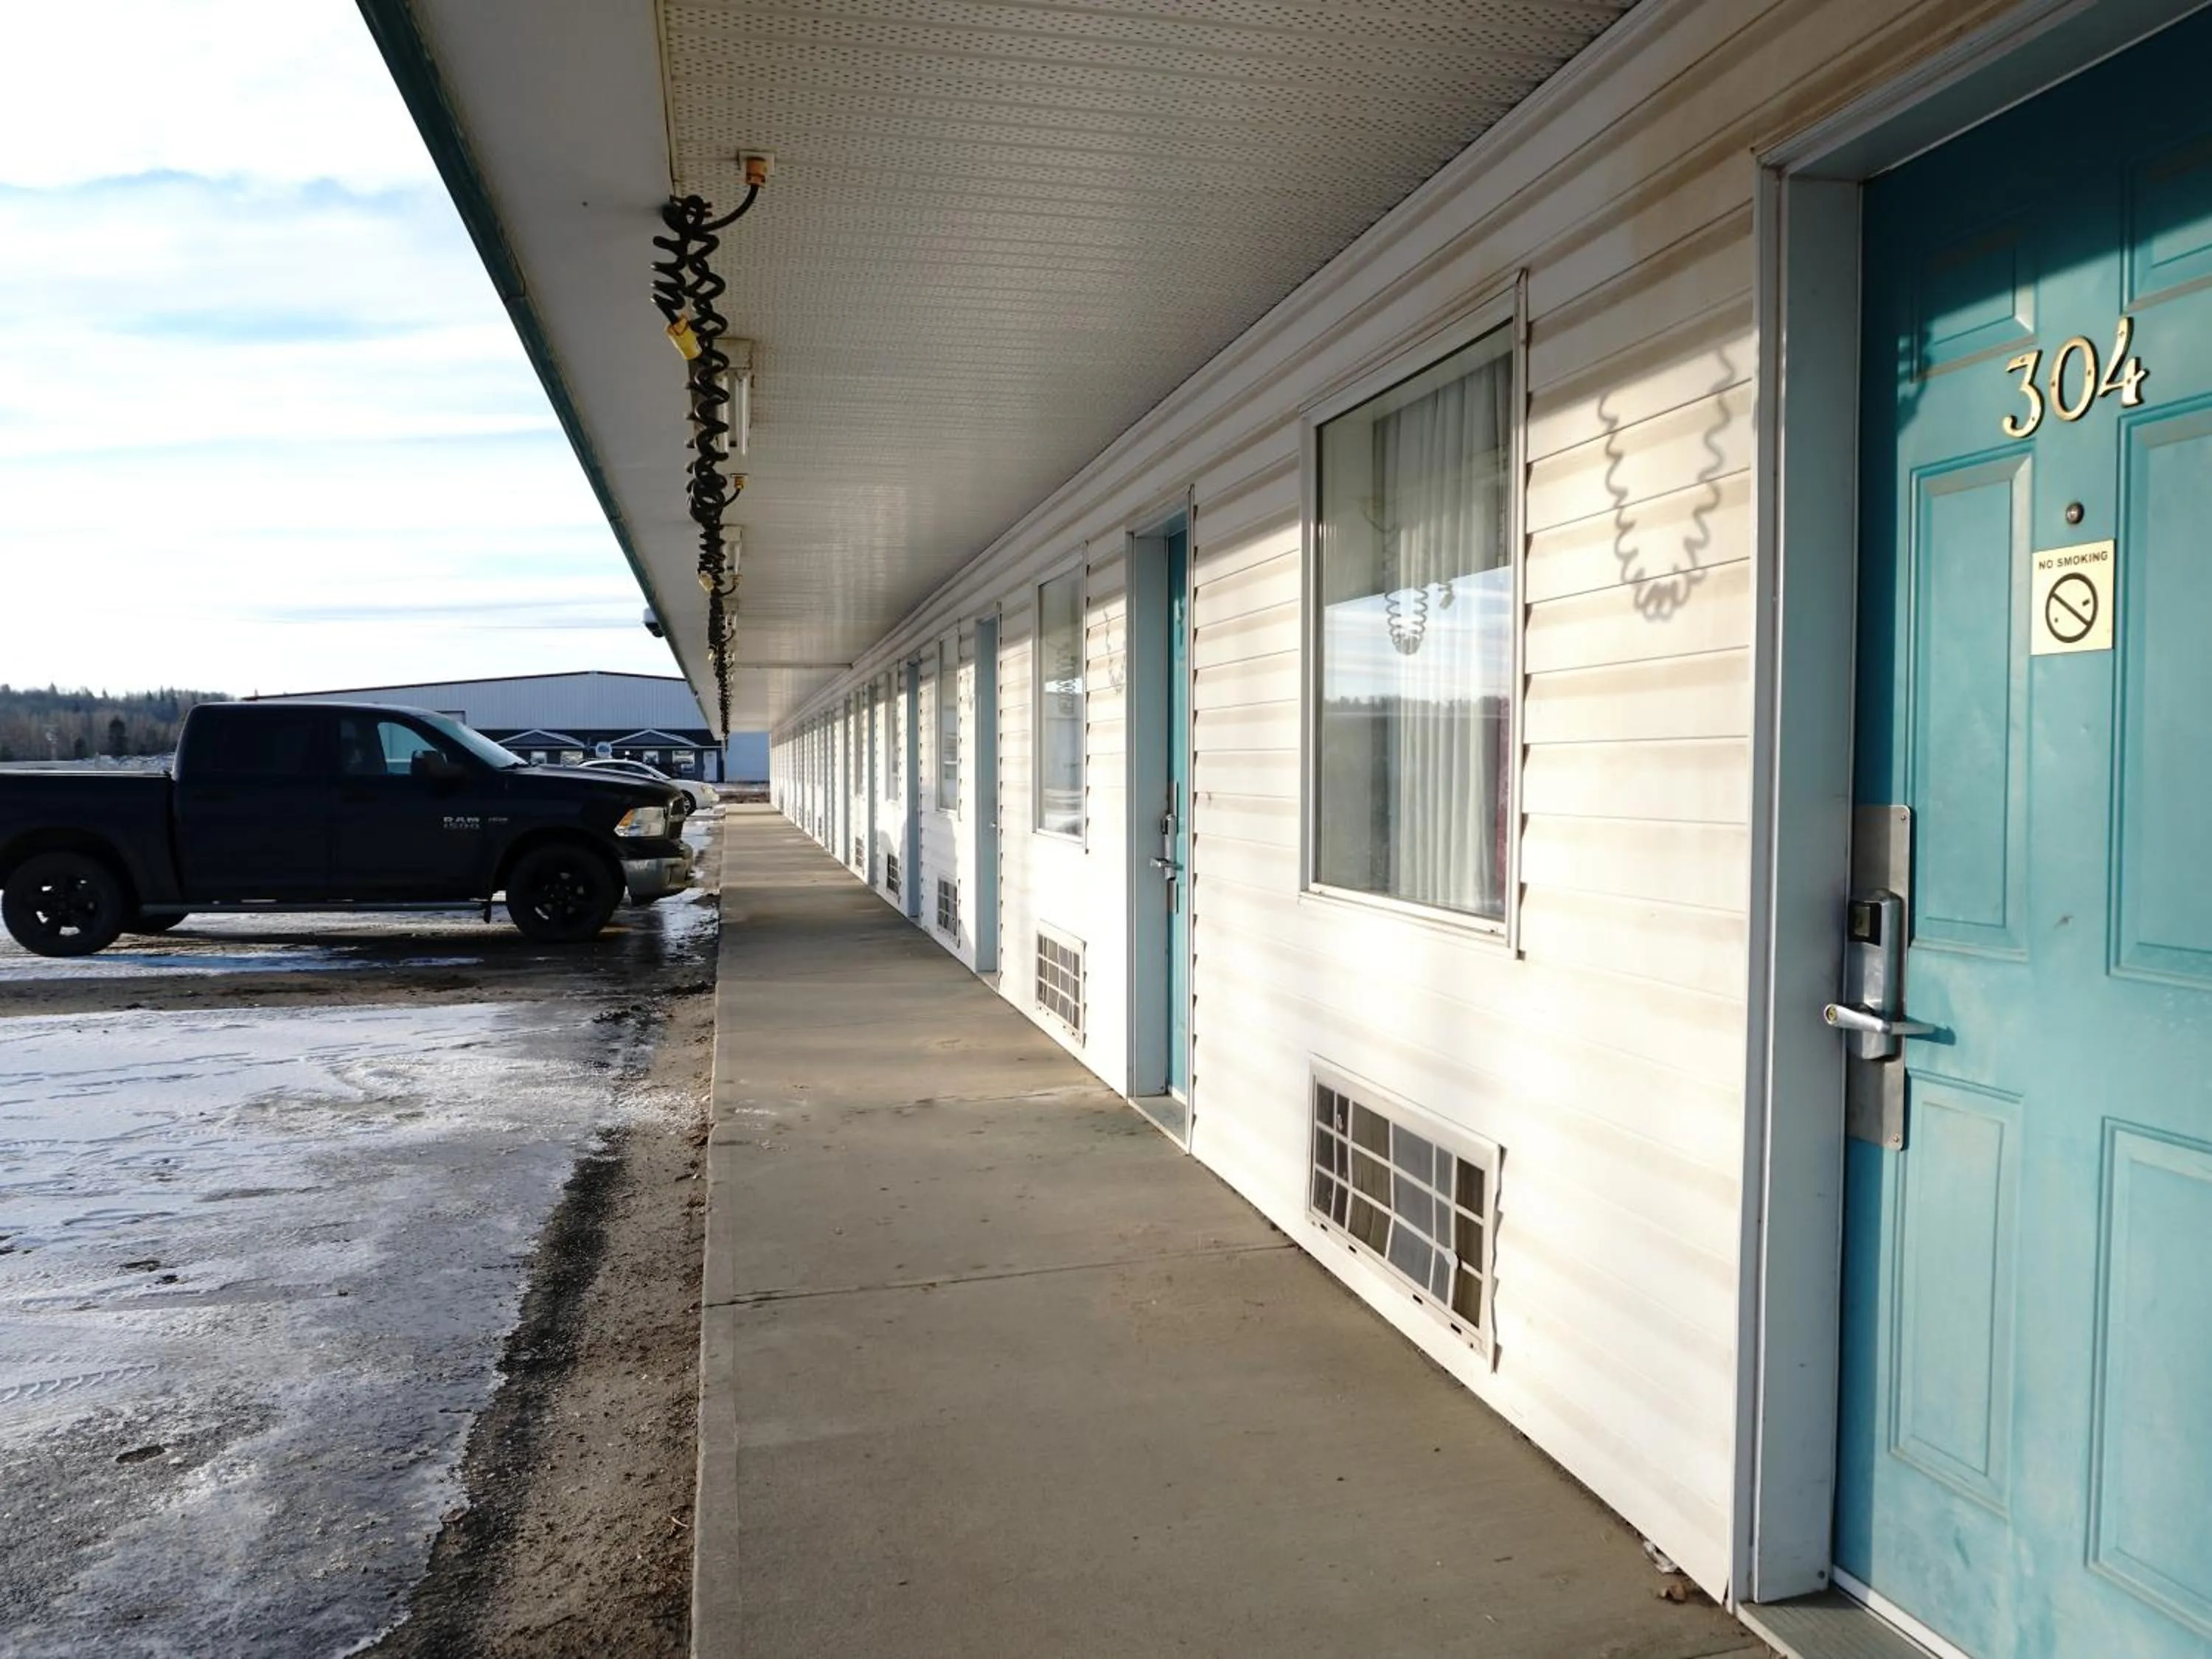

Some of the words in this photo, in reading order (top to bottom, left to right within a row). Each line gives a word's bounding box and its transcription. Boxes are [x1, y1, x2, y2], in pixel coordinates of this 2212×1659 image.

[2003, 316, 2149, 439] 304
[2038, 559, 2053, 570] NO
[2056, 550, 2109, 568] SMOKING
